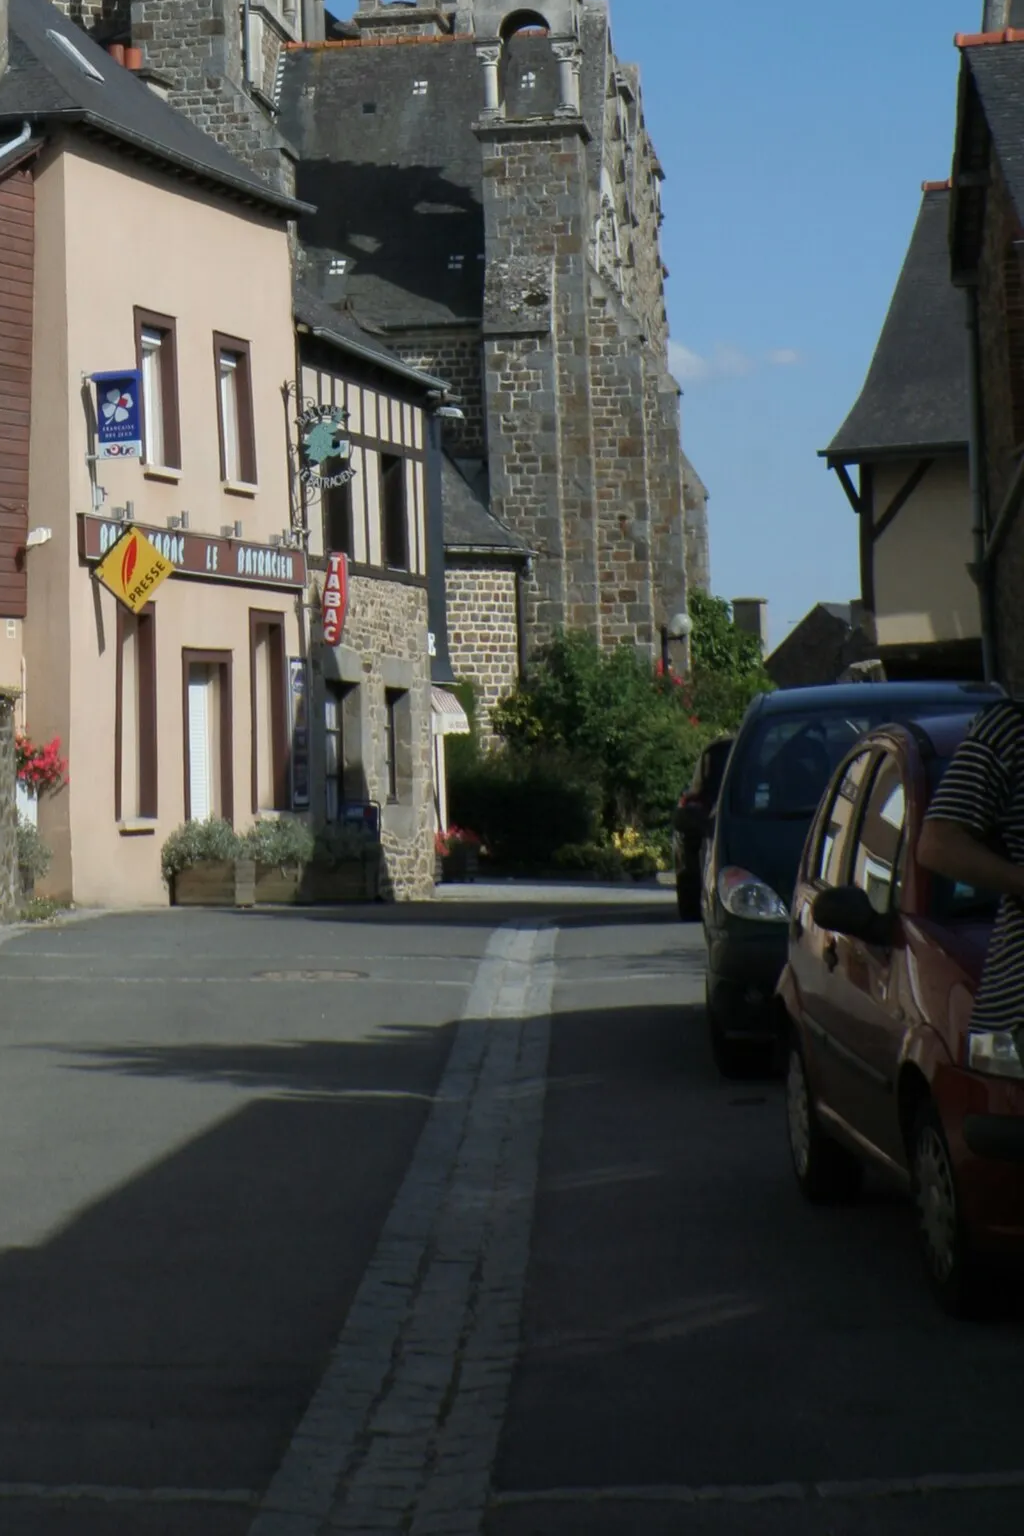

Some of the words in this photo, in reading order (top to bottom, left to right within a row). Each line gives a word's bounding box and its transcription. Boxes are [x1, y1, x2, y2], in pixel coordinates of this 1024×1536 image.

[129, 560, 166, 604] PRESSE
[206, 544, 218, 572] LE
[237, 546, 293, 581] BATRACIEN
[324, 556, 341, 643] TABAC
